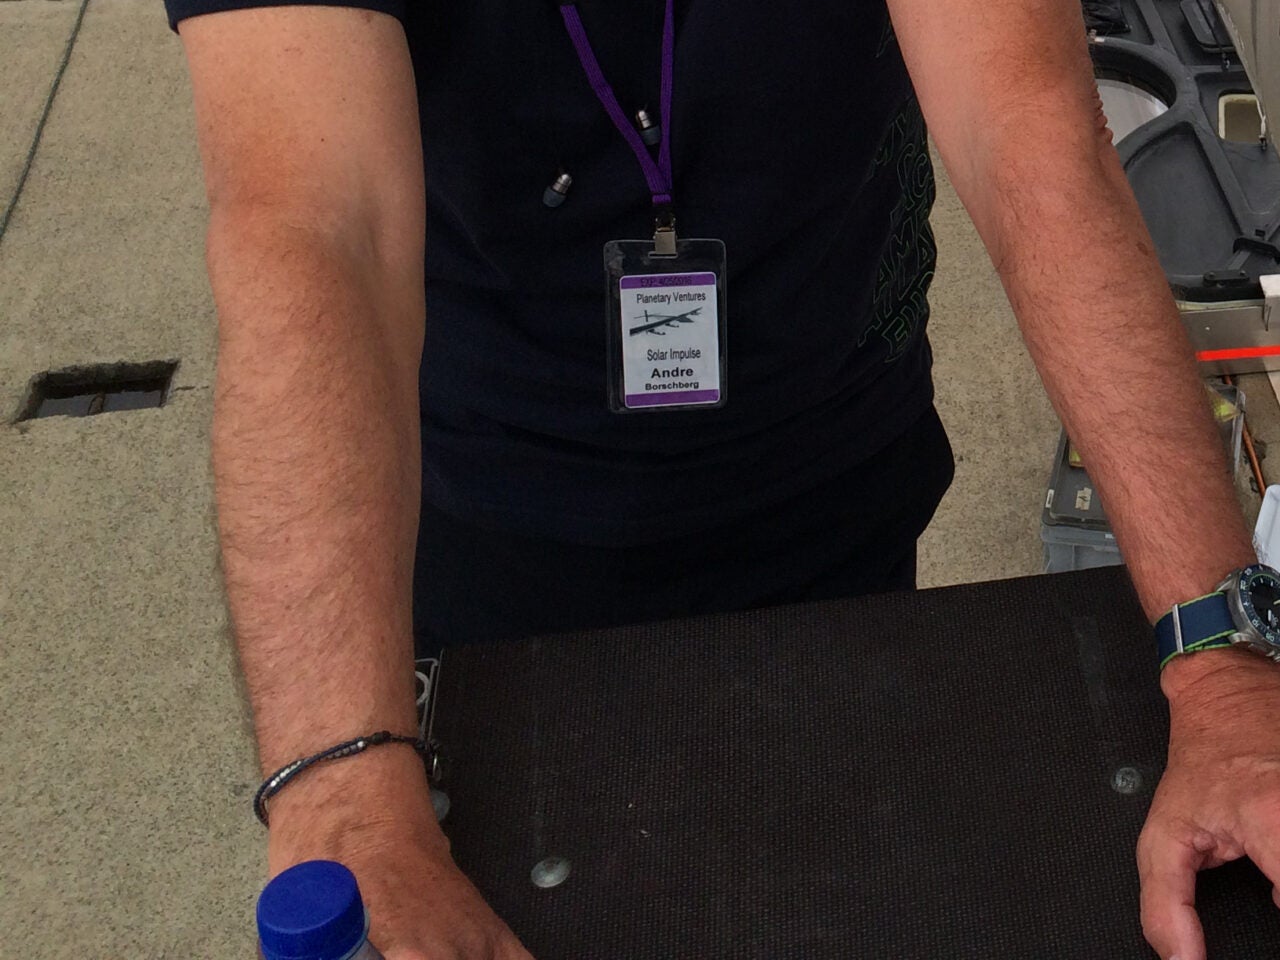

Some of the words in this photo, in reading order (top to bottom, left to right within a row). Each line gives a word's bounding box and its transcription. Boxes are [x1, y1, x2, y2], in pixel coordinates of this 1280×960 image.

[636, 293, 671, 304] Planetary
[673, 292, 706, 302] Ventures
[647, 349, 668, 361] Solar
[670, 347, 701, 361] Impulse
[651, 367, 694, 378] Andre
[645, 381, 699, 390] Borschberg
